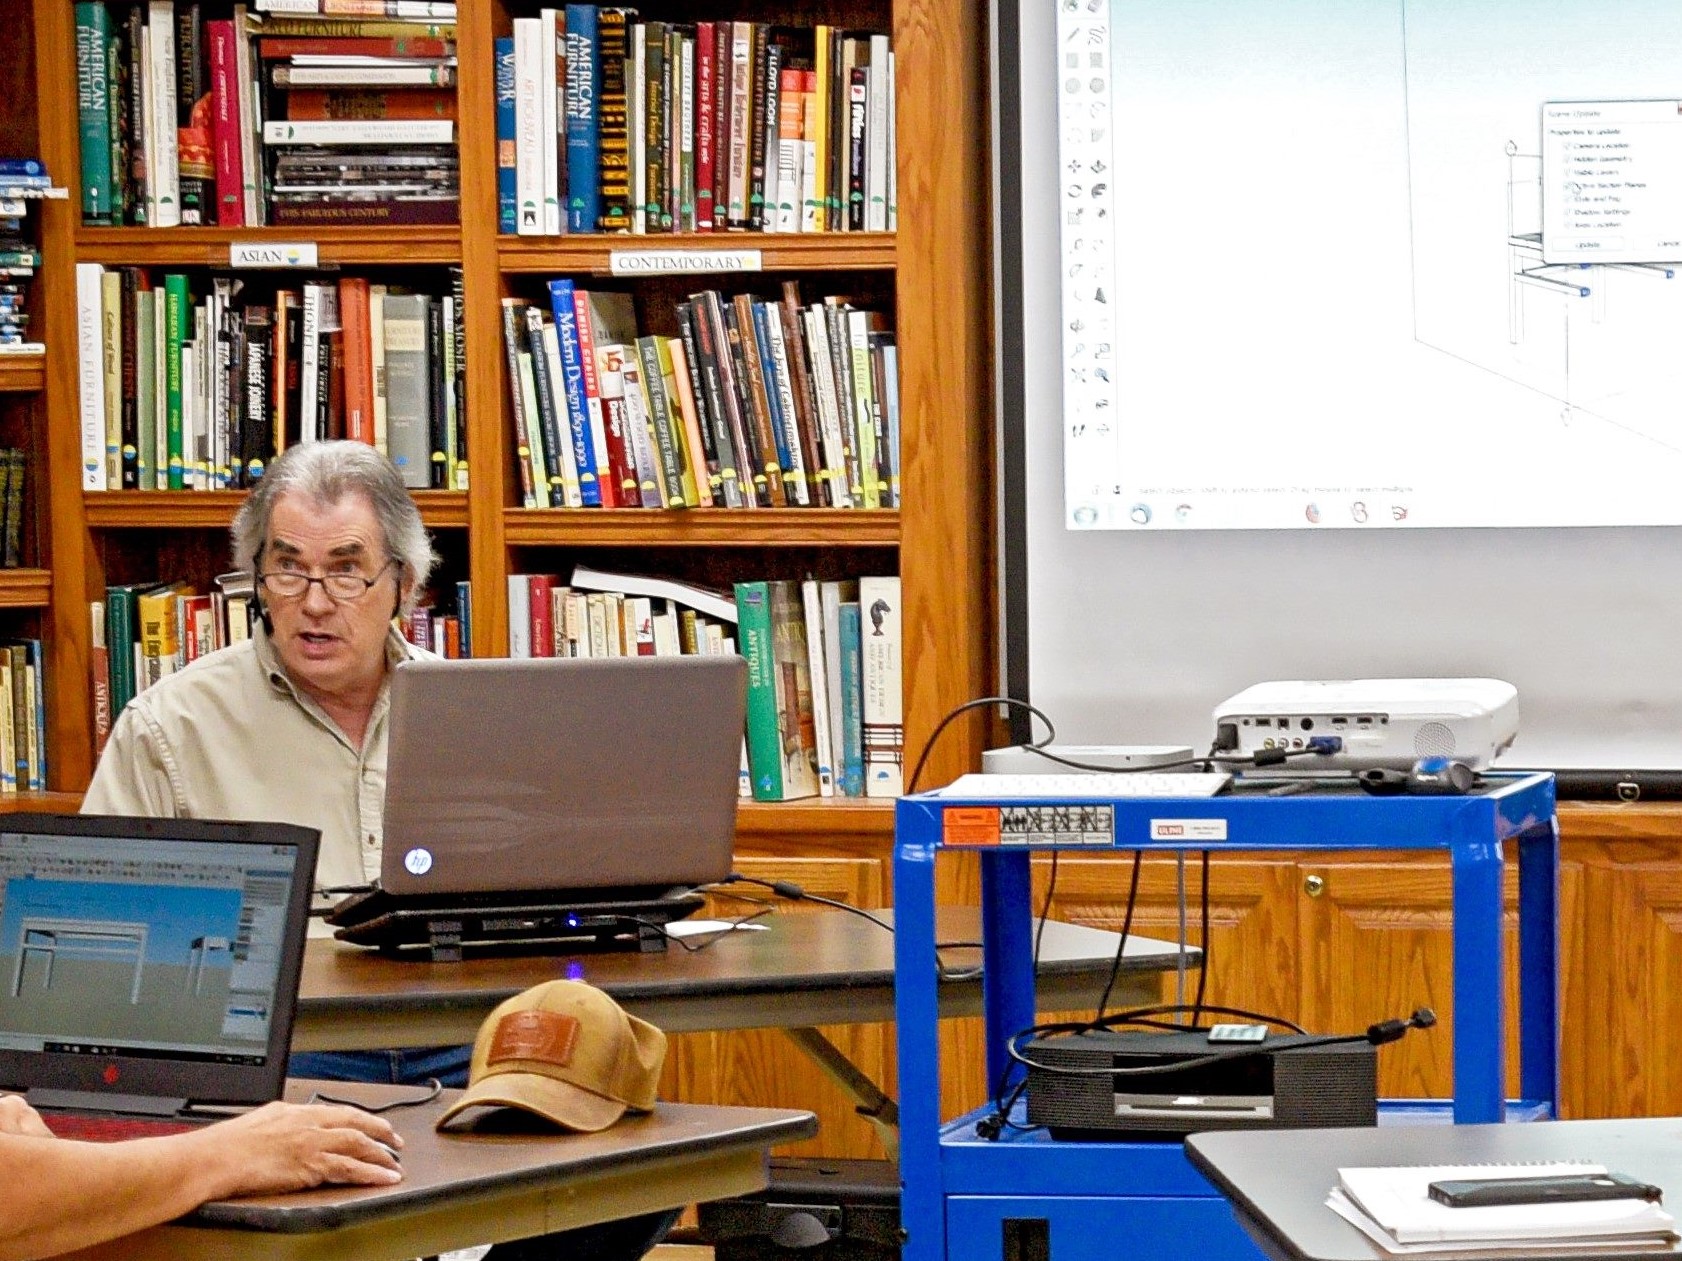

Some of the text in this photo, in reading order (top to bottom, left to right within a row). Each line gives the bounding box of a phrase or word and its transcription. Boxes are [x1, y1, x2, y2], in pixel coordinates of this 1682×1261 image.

[77, 26, 91, 109] FURNITURE
[90, 29, 106, 110] AMERICAN
[180, 14, 193, 106] FURNITURE
[566, 33, 579, 118] FURNITURE
[578, 36, 592, 119] AMERICAN
[717, 32, 725, 74] AMERICAN
[649, 80, 659, 114] Interior
[701, 80, 711, 101] arts
[701, 103, 711, 114] &
[716, 76, 725, 122] FURNITURE
[767, 56, 778, 126] LLOYD LOOM
[133, 96, 142, 141] FURNITURE
[648, 116, 659, 146] Design
[701, 116, 711, 146] crafts
[852, 104, 865, 176] fifties furniture
[348, 208, 389, 218] CENTURY
[239, 250, 283, 262] ASIAN
[618, 256, 744, 271] CONTEMPORARY
[304, 294, 315, 348] THONET
[558, 313, 574, 364] Modern
[577, 300, 595, 391] DANISH CHAIRS
[170, 342, 179, 393] FURNITURE
[454, 324, 465, 373] MOSER
[853, 333, 866, 394] furniture
[81, 305, 97, 452] ASIAN FURNITURE
[248, 343, 266, 421] JAPANESE JOINERY
[564, 366, 582, 410] Design
[608, 401, 622, 437] Design
[644, 346, 679, 496] THE COFFEE TABLE COFFEE TABLE BOOK
[780, 390, 800, 470] Cabinetmaking
[146, 622, 161, 636] The
[556, 632, 566, 657] Ame
[747, 629, 761, 688] ANTIQUES
[95, 681, 107, 734] ANTIQUES
[1158, 825, 1184, 836] ULINE
[412, 853, 429, 870] hp
